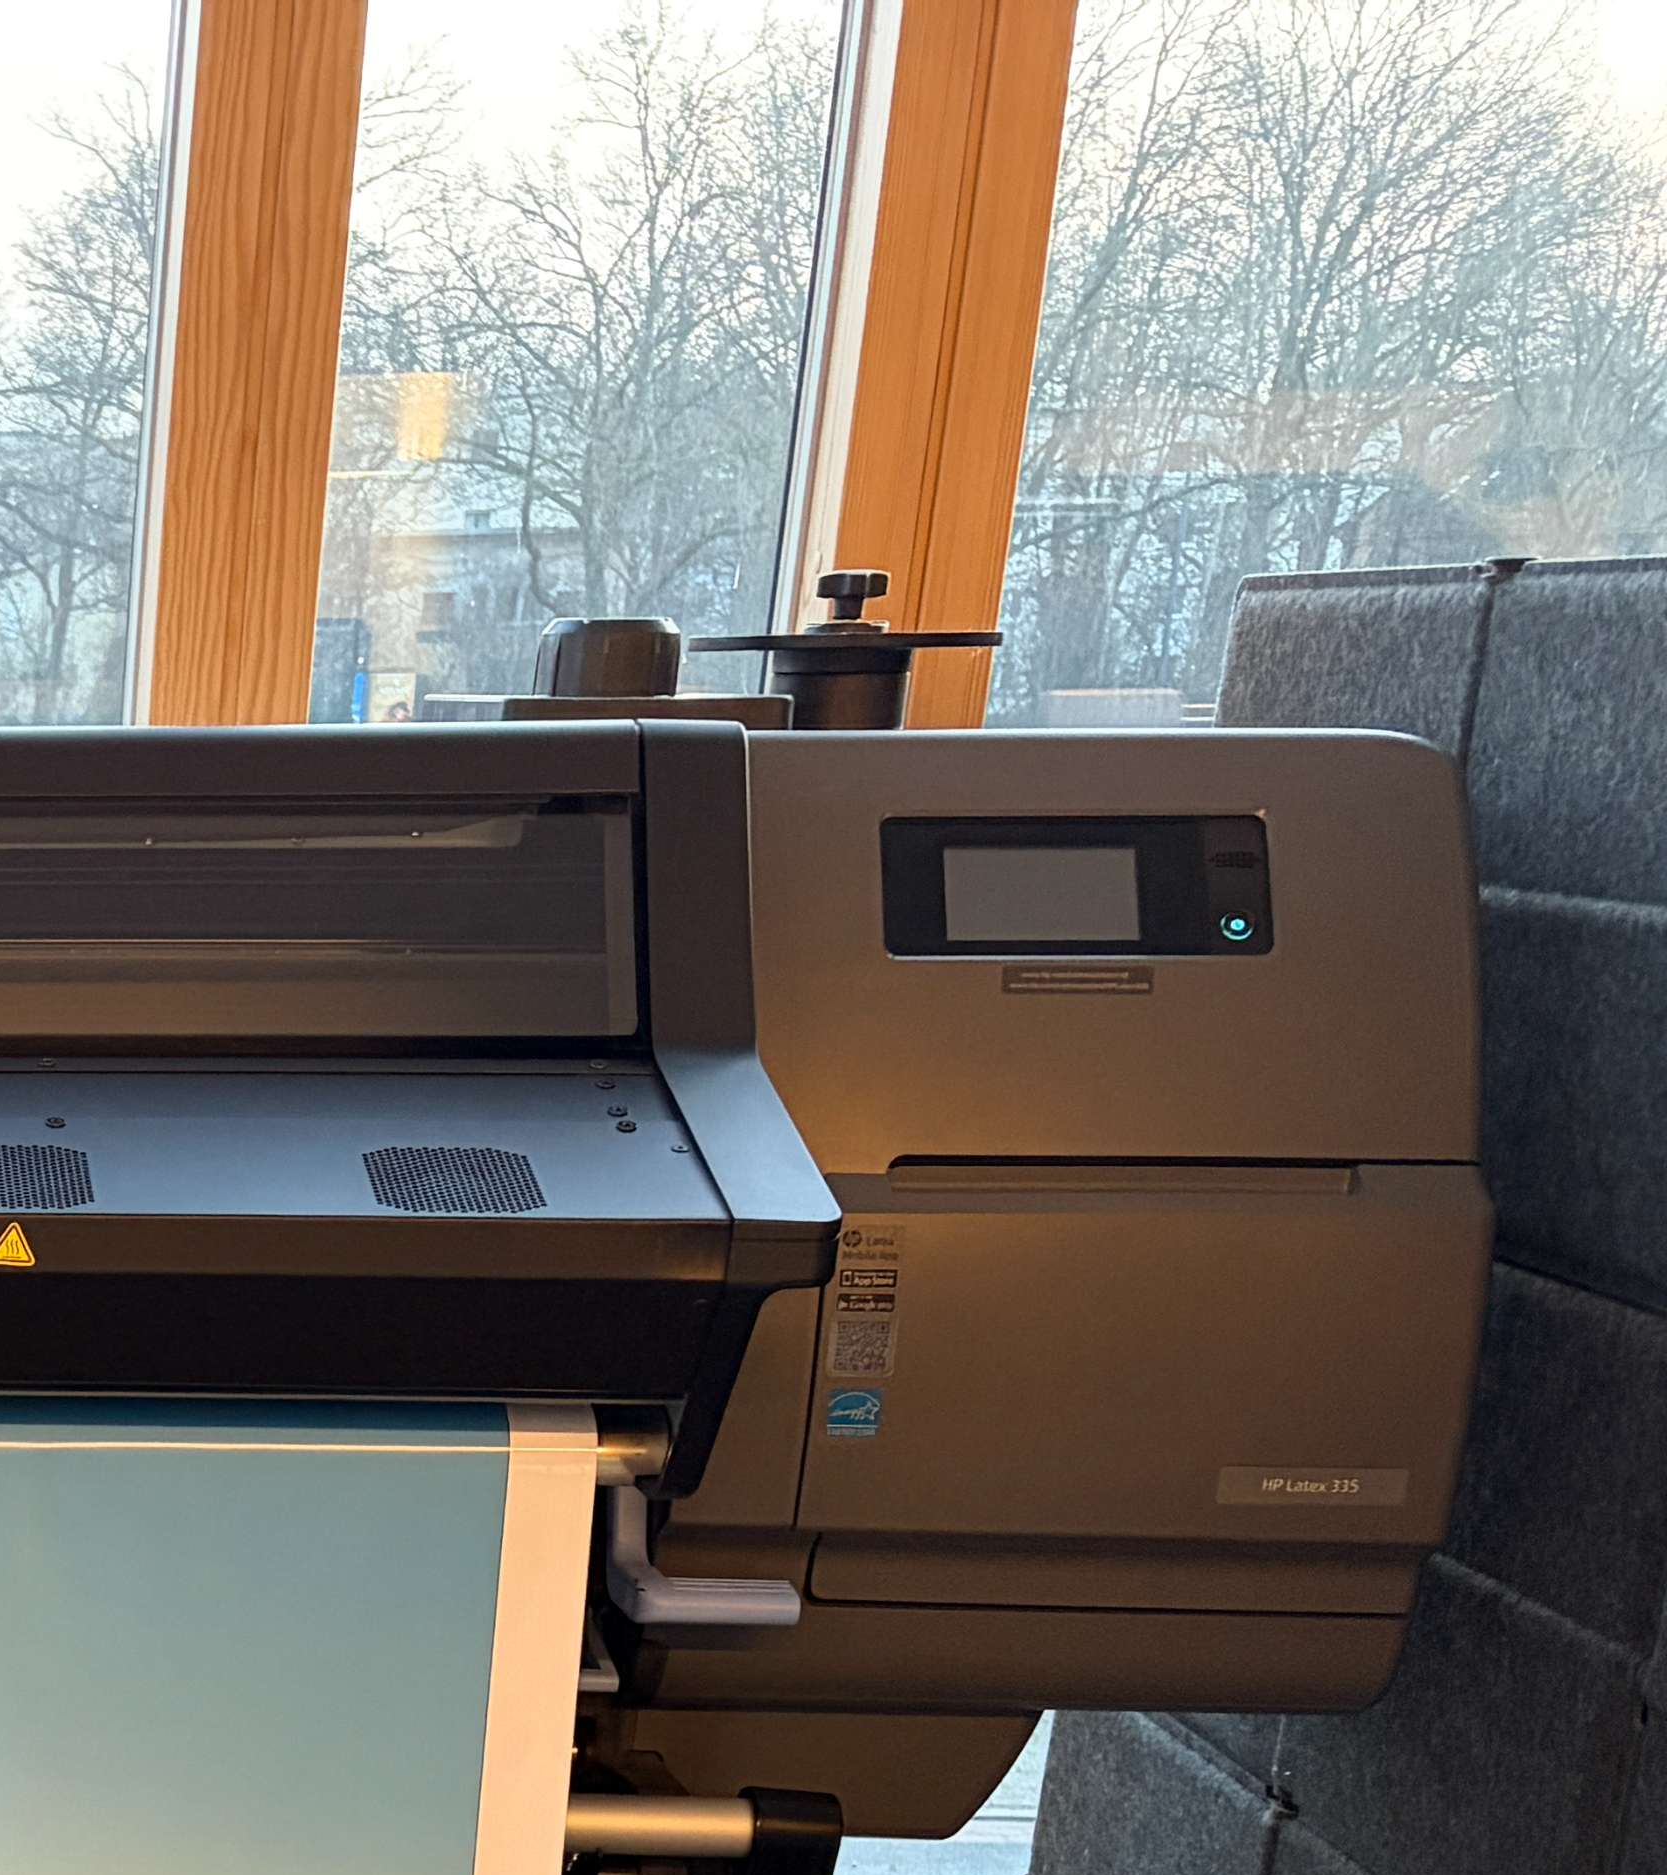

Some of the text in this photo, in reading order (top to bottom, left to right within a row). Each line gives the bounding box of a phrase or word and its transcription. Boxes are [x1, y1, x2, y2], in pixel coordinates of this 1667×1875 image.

[1262, 1478, 1360, 1493] HP Latex 335
